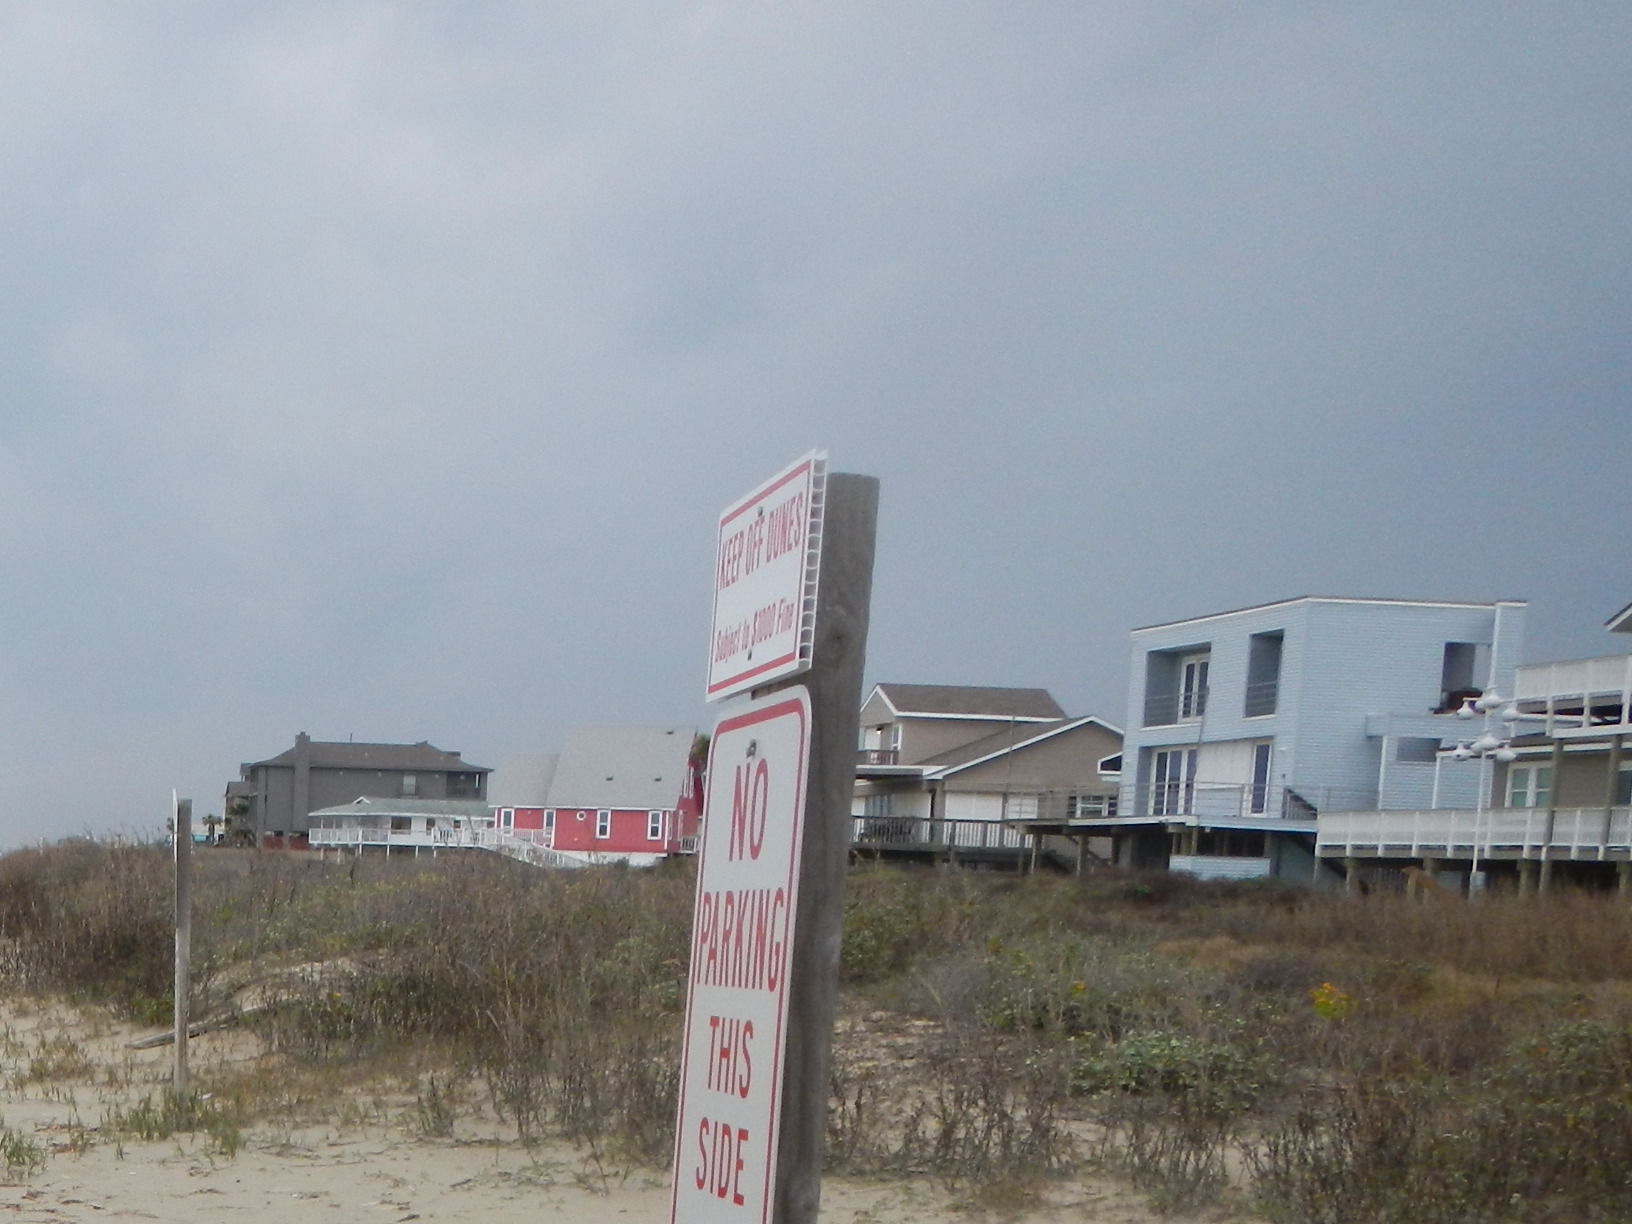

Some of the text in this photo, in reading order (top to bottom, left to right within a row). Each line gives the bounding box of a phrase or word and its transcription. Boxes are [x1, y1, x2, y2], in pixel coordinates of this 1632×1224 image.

[718, 491, 804, 590] KEEP OFF DUNES
[714, 622, 741, 664] Subject
[741, 617, 750, 651] to
[775, 597, 795, 635] Fine
[729, 758, 769, 862] NO
[696, 886, 785, 993] PARKING
[707, 1015, 754, 1099] THIS
[695, 1116, 750, 1207] SIDE
